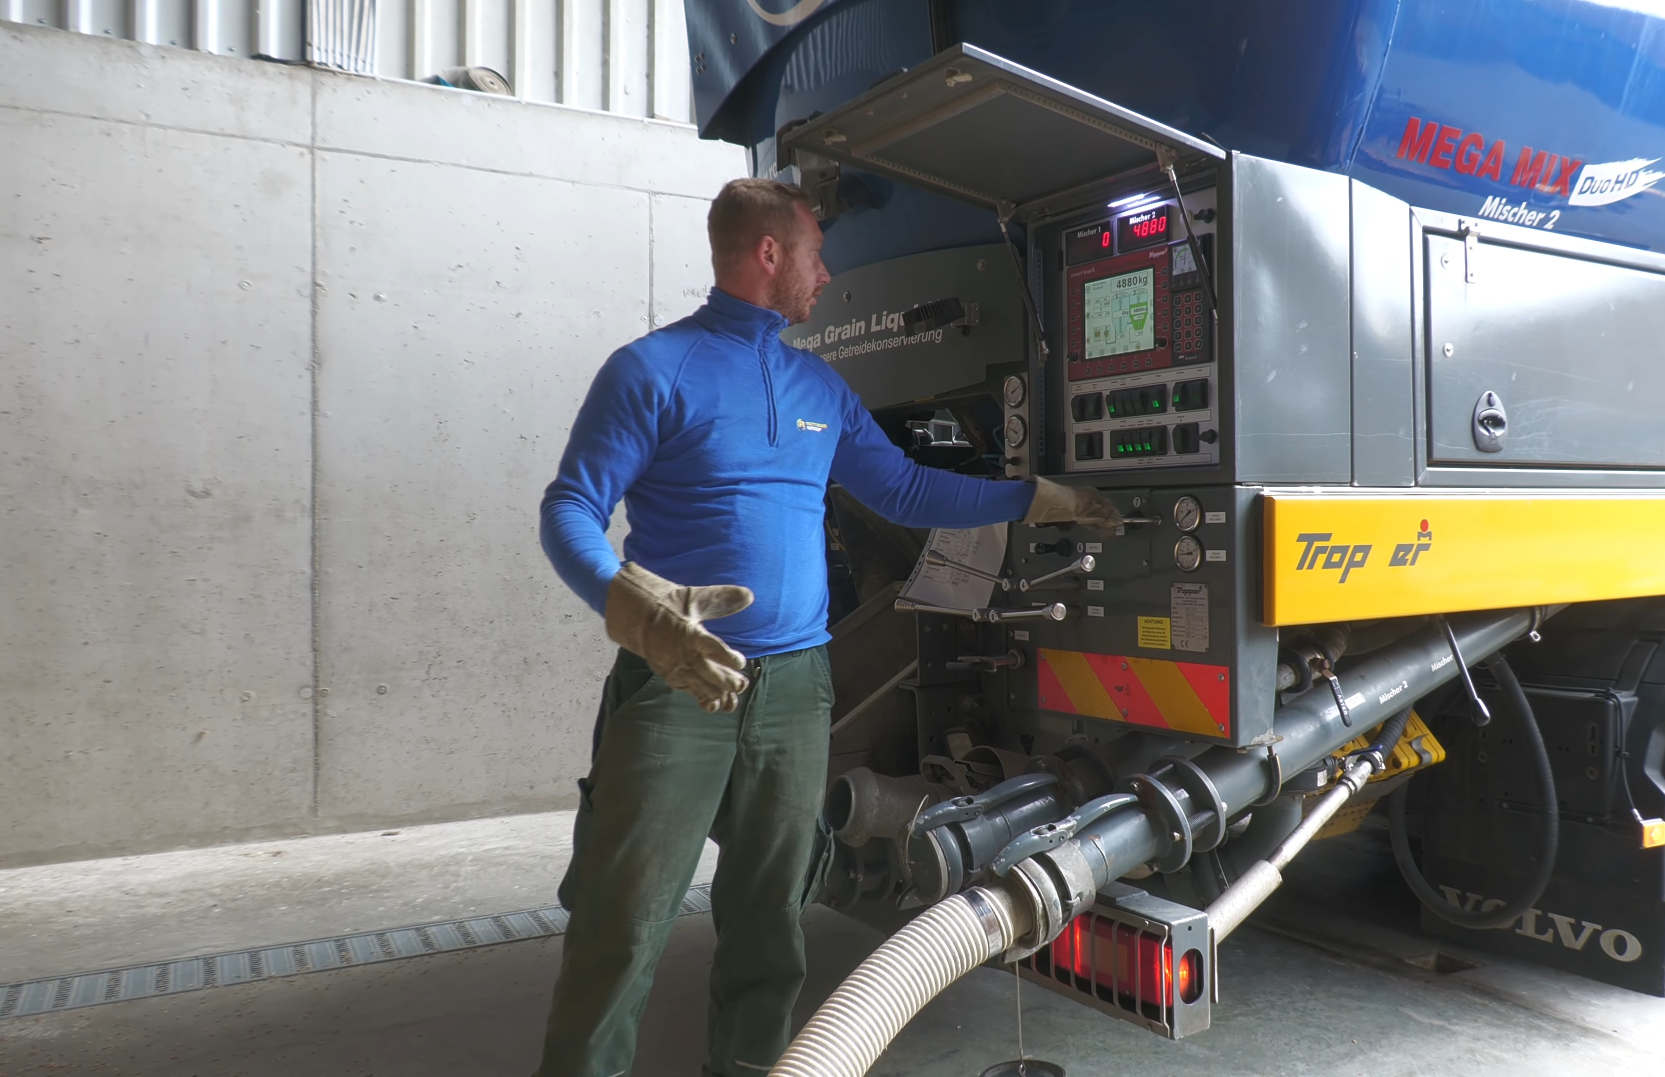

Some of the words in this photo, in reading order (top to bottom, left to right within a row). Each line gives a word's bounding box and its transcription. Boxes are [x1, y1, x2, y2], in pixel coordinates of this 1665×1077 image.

[1395, 116, 1506, 183] MEGA
[1509, 146, 1583, 198] MIX
[1129, 213, 1150, 225] Mischer
[1478, 195, 1545, 227] Mischer
[1543, 210, 1561, 230] 2
[1077, 229, 1097, 238] Mischer
[1133, 216, 1166, 237] 4880
[1102, 232, 1110, 247] 0
[824, 319, 866, 344] Grain
[838, 328, 943, 359] Getreidekonservierung
[1430, 654, 1454, 672] Mischer
[1378, 686, 1404, 704] Mischer
[1402, 680, 1409, 689] 2
